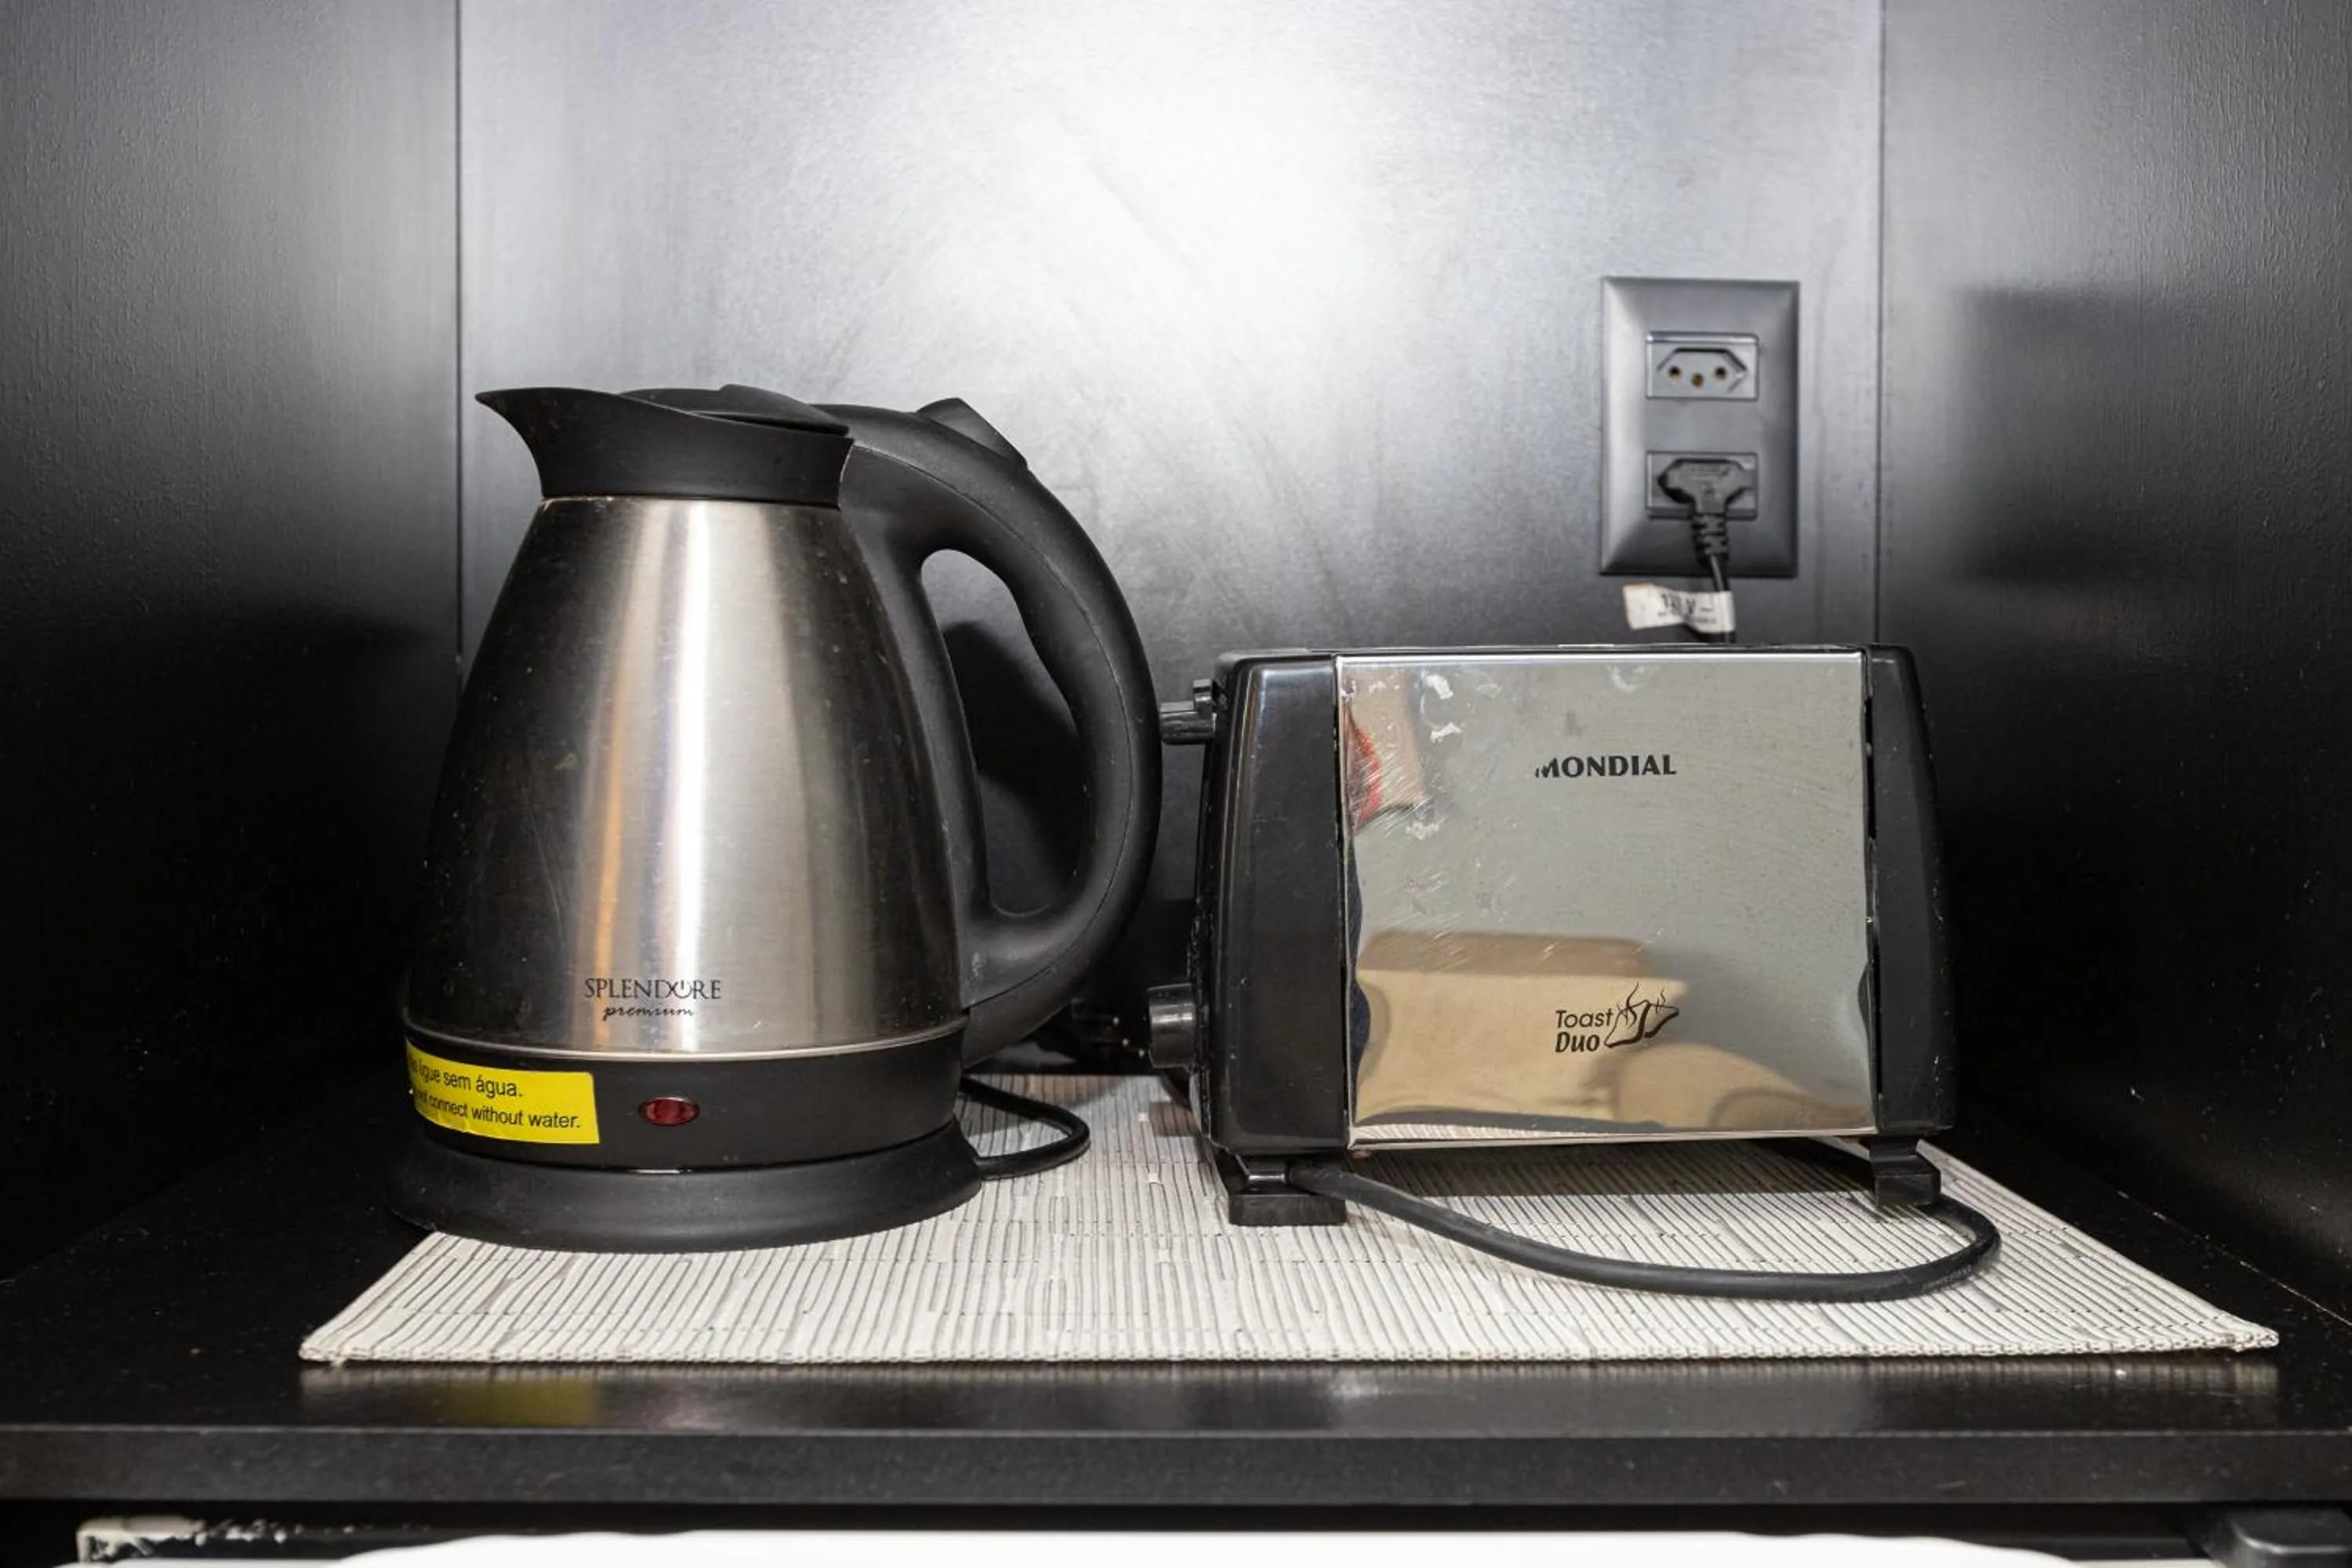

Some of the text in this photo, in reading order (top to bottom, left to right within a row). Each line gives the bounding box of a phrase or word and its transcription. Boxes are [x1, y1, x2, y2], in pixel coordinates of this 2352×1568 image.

[584, 978, 722, 1000] SPLENDORE
[602, 1004, 694, 1022] premium
[1555, 1007, 1614, 1029] Toast
[1555, 1032, 1600, 1053] Duo
[443, 1071, 471, 1091] sem
[476, 1074, 523, 1099] água.
[471, 1105, 524, 1127] without
[528, 1112, 581, 1128] water.
